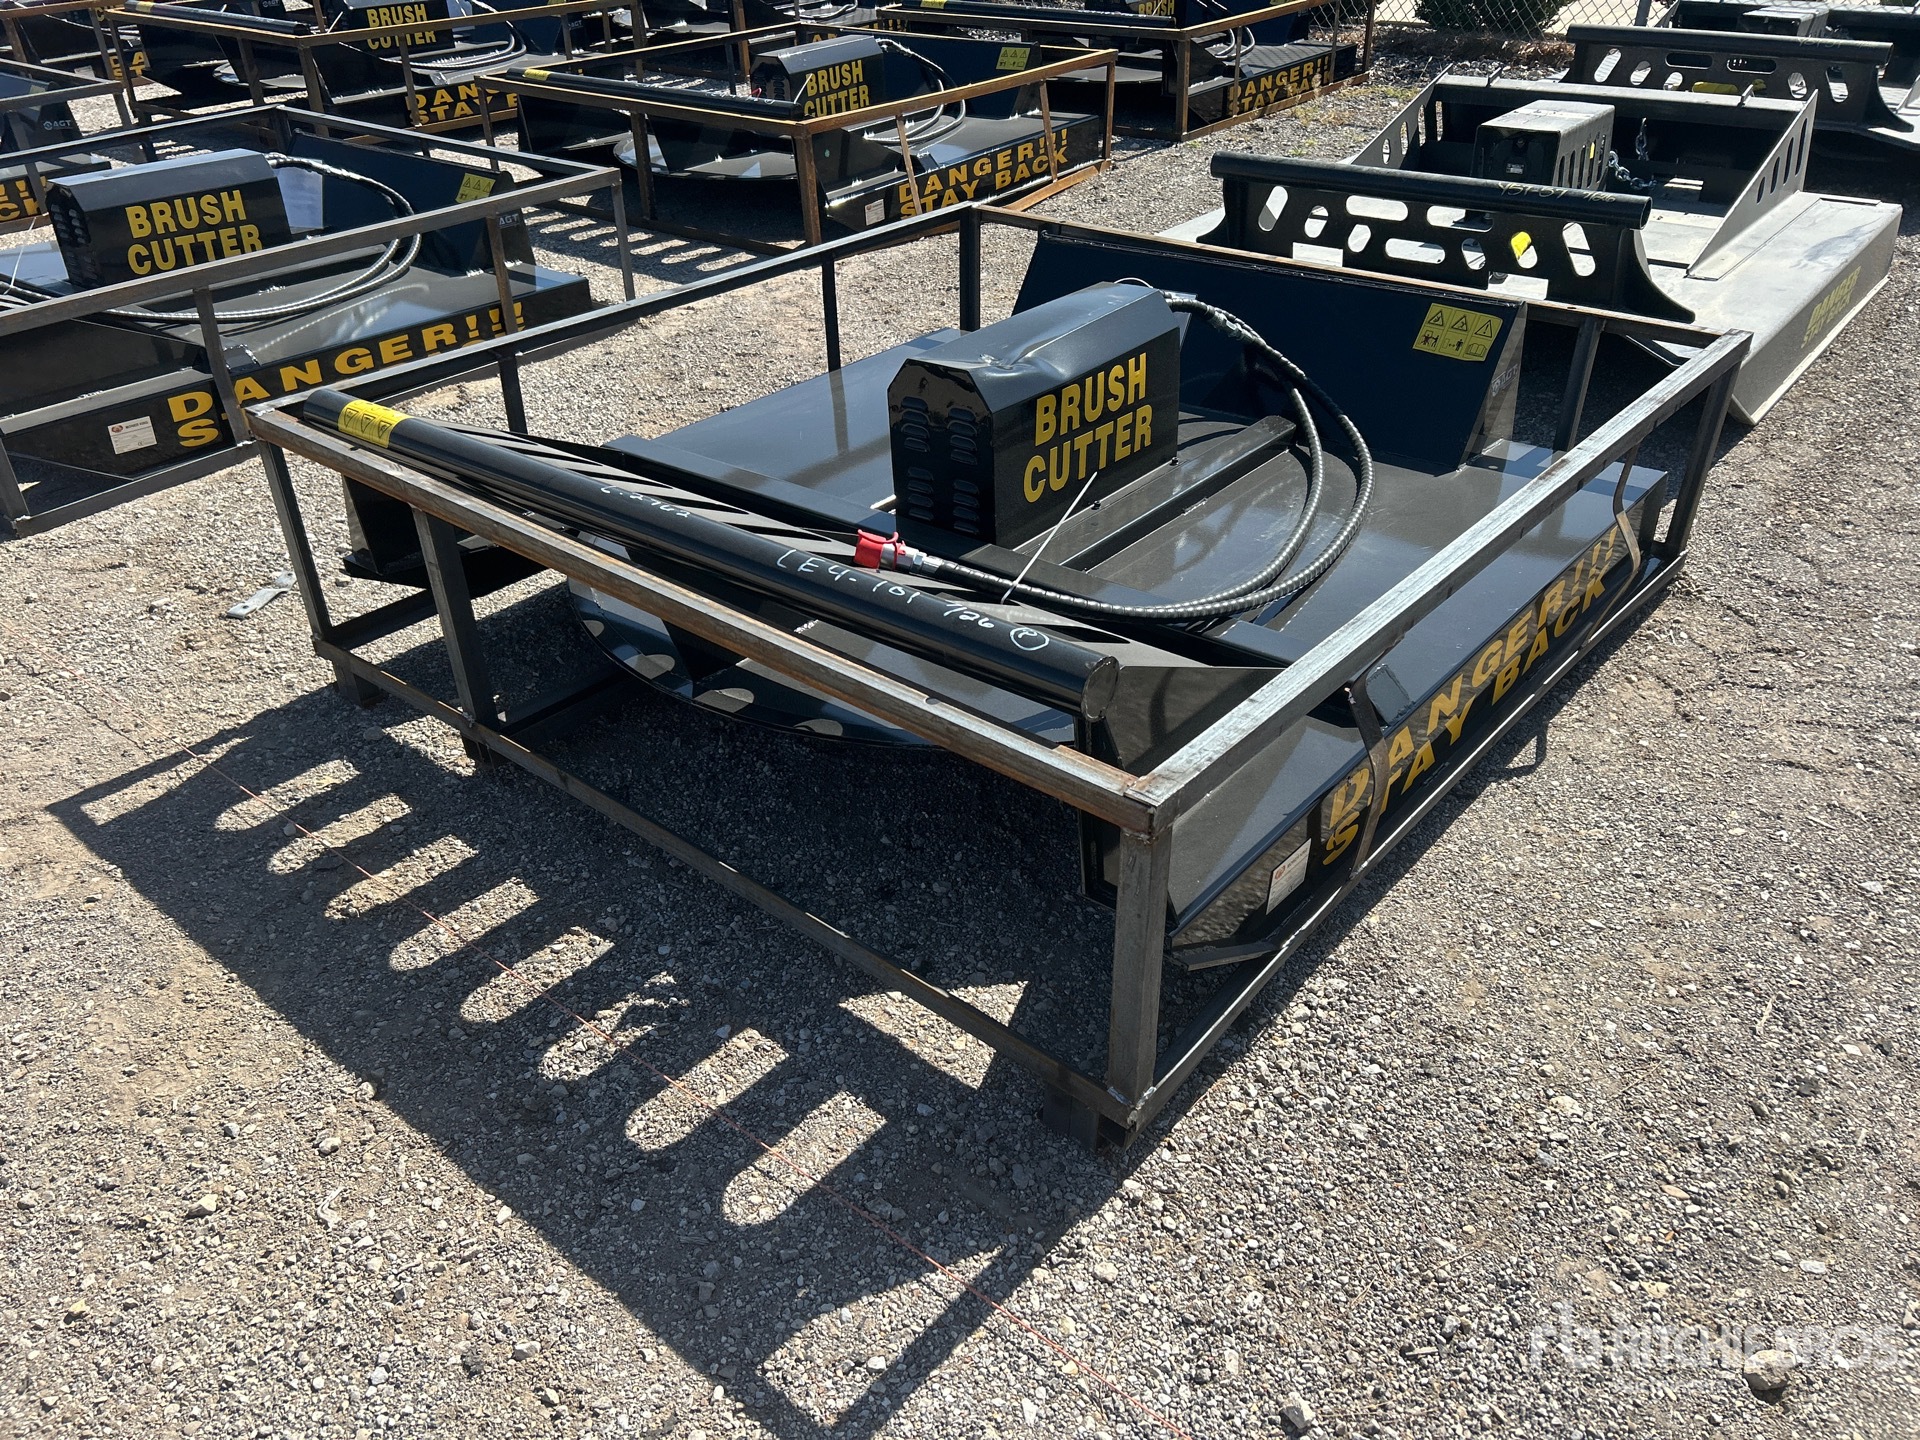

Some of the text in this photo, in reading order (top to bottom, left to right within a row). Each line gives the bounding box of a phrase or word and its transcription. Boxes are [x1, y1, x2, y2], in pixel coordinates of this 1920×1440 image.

[366, 3, 428, 28] BRUSH
[804, 84, 870, 118] CUTTER
[805, 59, 864, 97] BRUSH
[995, 146, 1068, 190] BACK
[125, 189, 247, 239] BRUSH
[127, 224, 264, 276] CUTTER
[167, 301, 525, 423] DANGER!!!
[1035, 352, 1147, 447] BRUSH
[1023, 404, 1153, 503] CUTTER
[1328, 527, 1619, 830] DANGER!!!
[1322, 562, 1610, 867] STAY BACK
